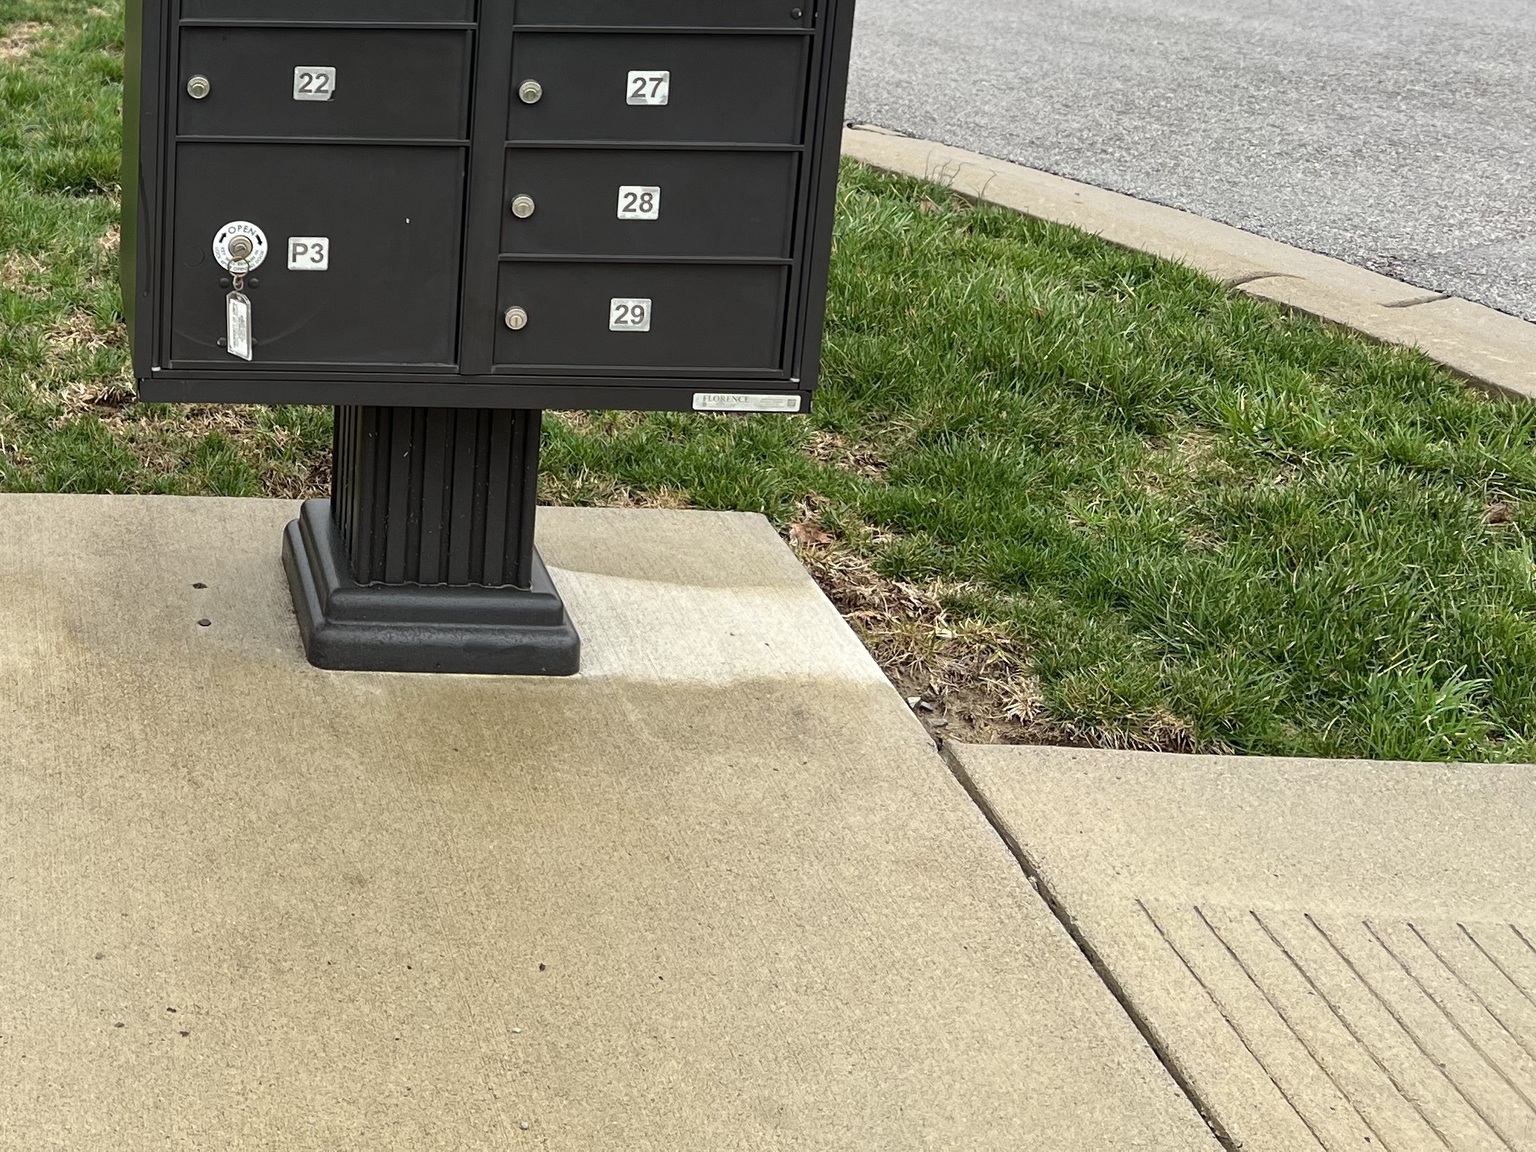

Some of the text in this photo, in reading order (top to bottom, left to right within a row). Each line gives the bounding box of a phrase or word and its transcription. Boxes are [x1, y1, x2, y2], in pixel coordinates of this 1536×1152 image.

[298, 73, 329, 94] 22
[631, 77, 663, 98] 27
[623, 193, 653, 212] 28
[228, 225, 257, 236] OPEN
[292, 243, 324, 263] P3
[614, 305, 644, 325] 29
[702, 394, 749, 403] FLORENCE
